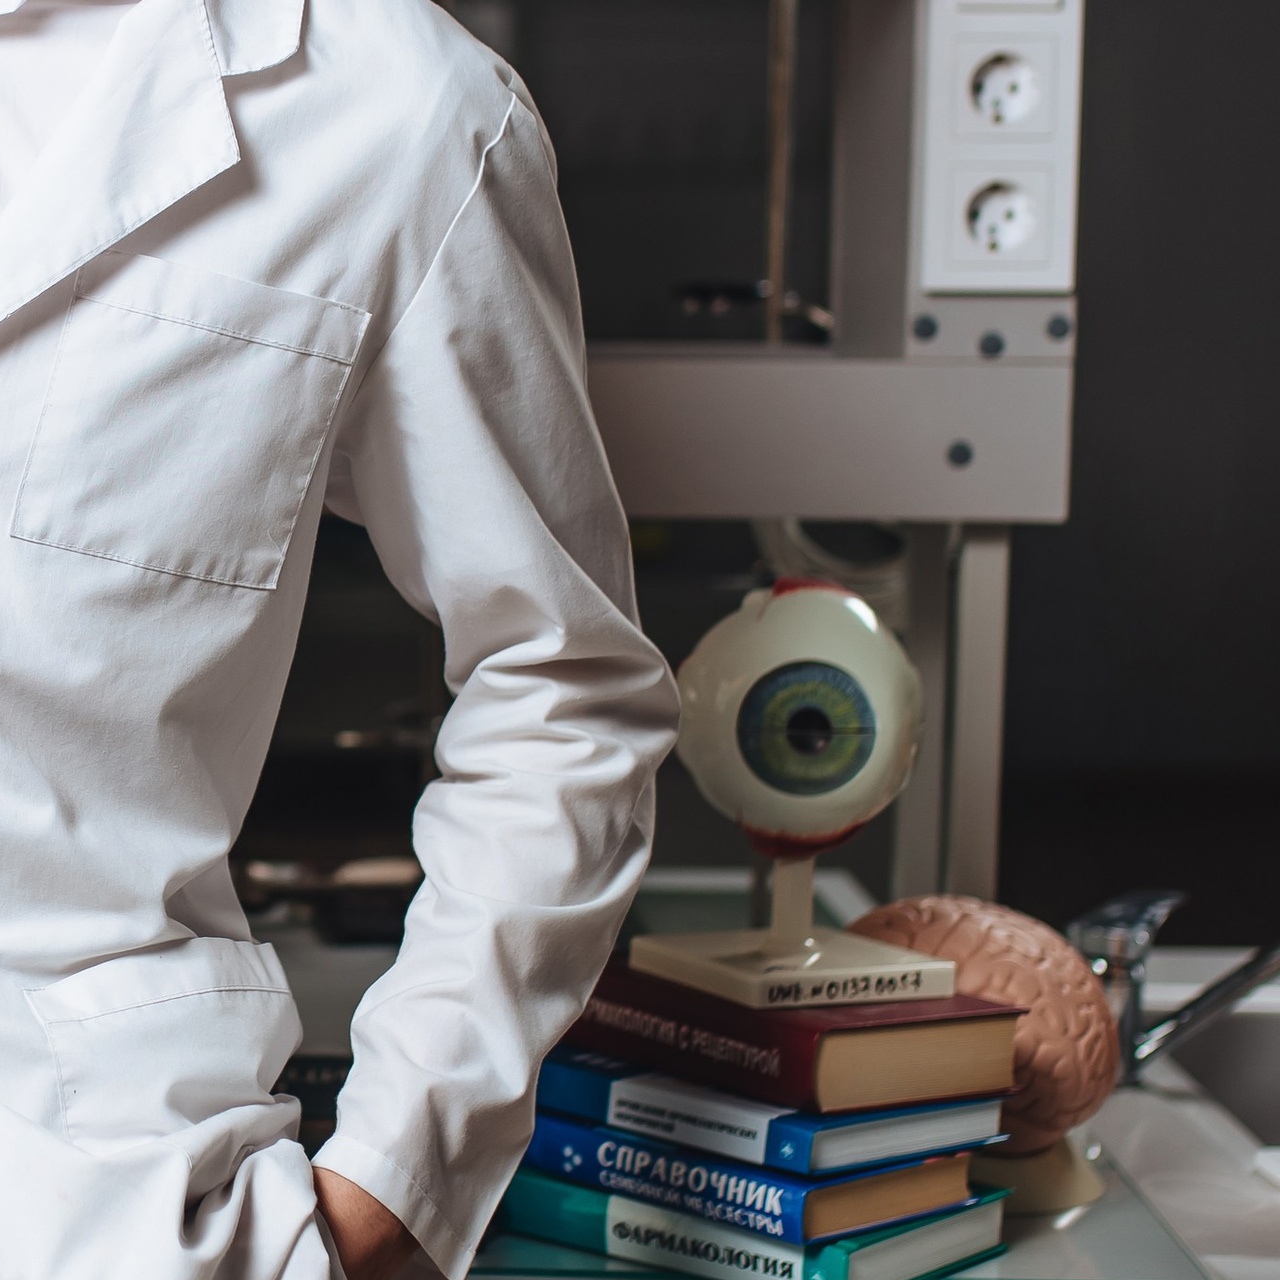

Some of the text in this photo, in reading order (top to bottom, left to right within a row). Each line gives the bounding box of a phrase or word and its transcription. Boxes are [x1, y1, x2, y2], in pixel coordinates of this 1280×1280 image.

[692, 1029, 782, 1078] РЕЦЕПТУРОЙ
[596, 1141, 785, 1216] СПРАВОЧНИК
[612, 1221, 795, 1280] ФАРМАКОЛОГИЯ
